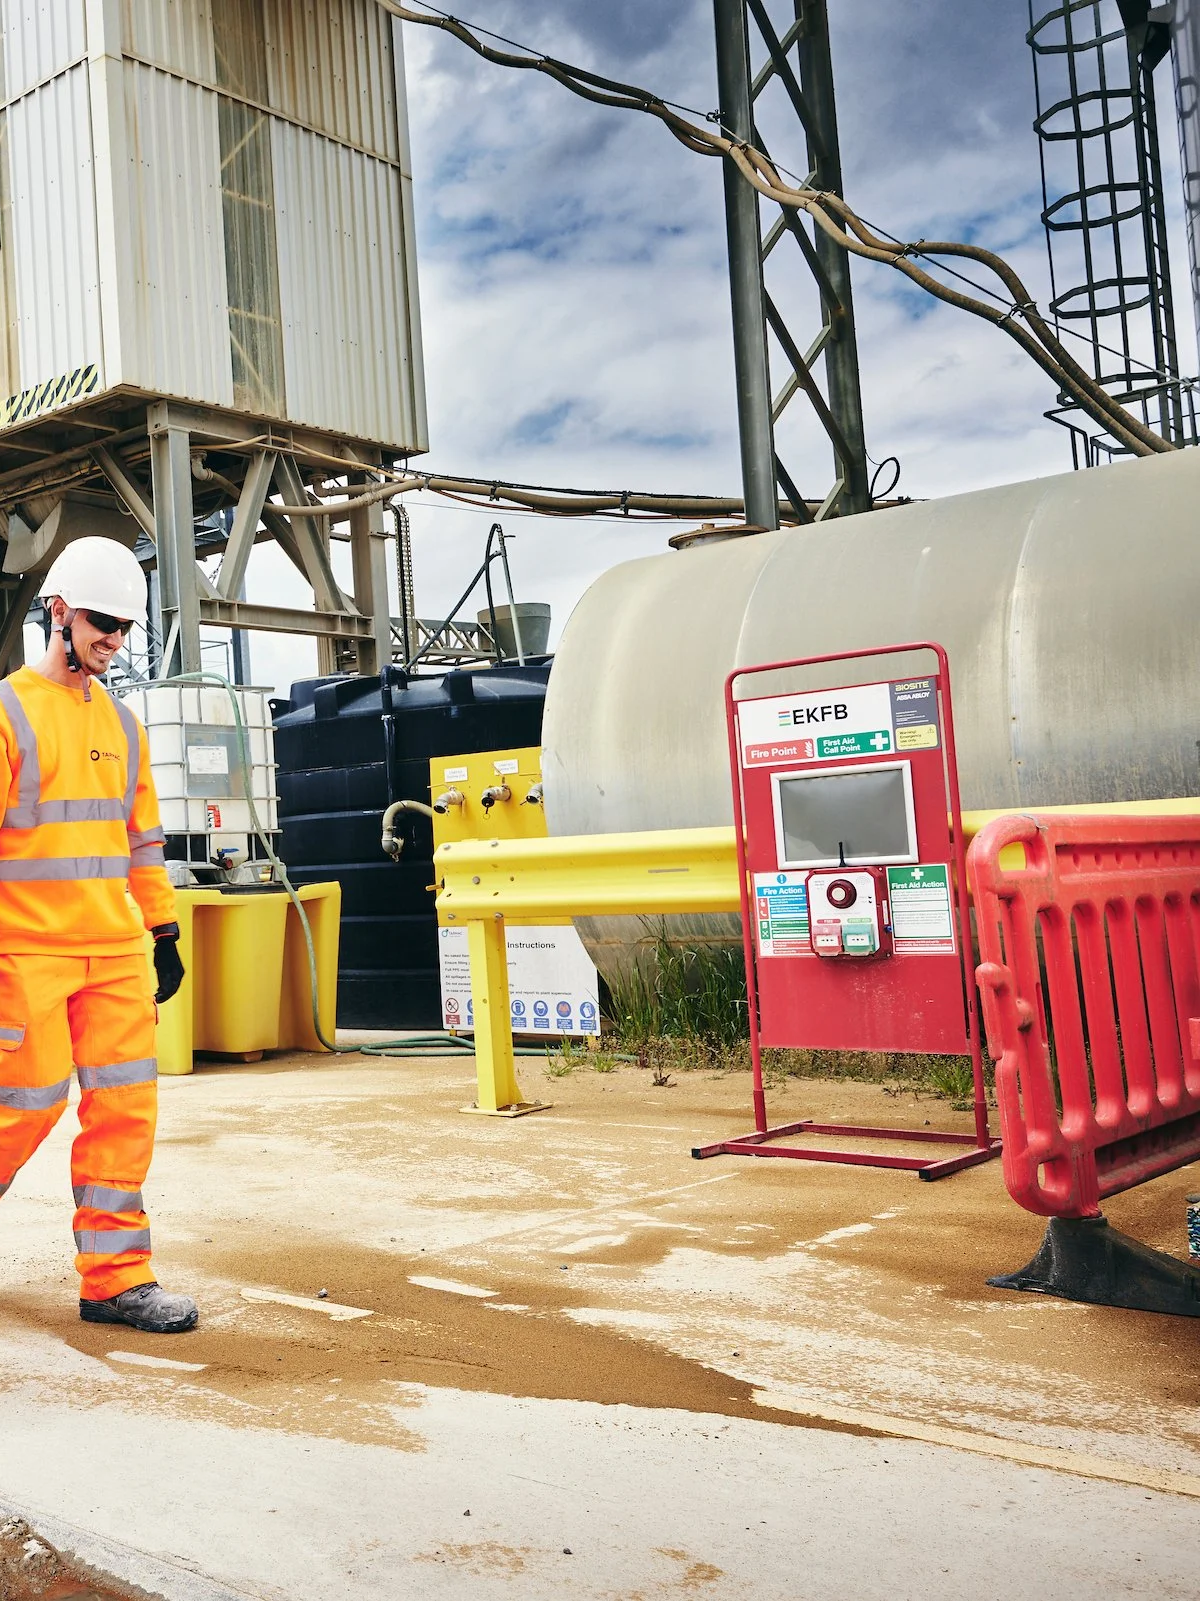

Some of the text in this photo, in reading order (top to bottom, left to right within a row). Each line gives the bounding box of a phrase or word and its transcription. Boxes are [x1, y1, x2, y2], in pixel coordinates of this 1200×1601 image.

[895, 681, 930, 692] BIOSITE
[792, 704, 848, 724] EKFB
[822, 736, 855, 748] First Aid
[751, 746, 798, 759] Fire Point
[823, 744, 861, 754] Call Point
